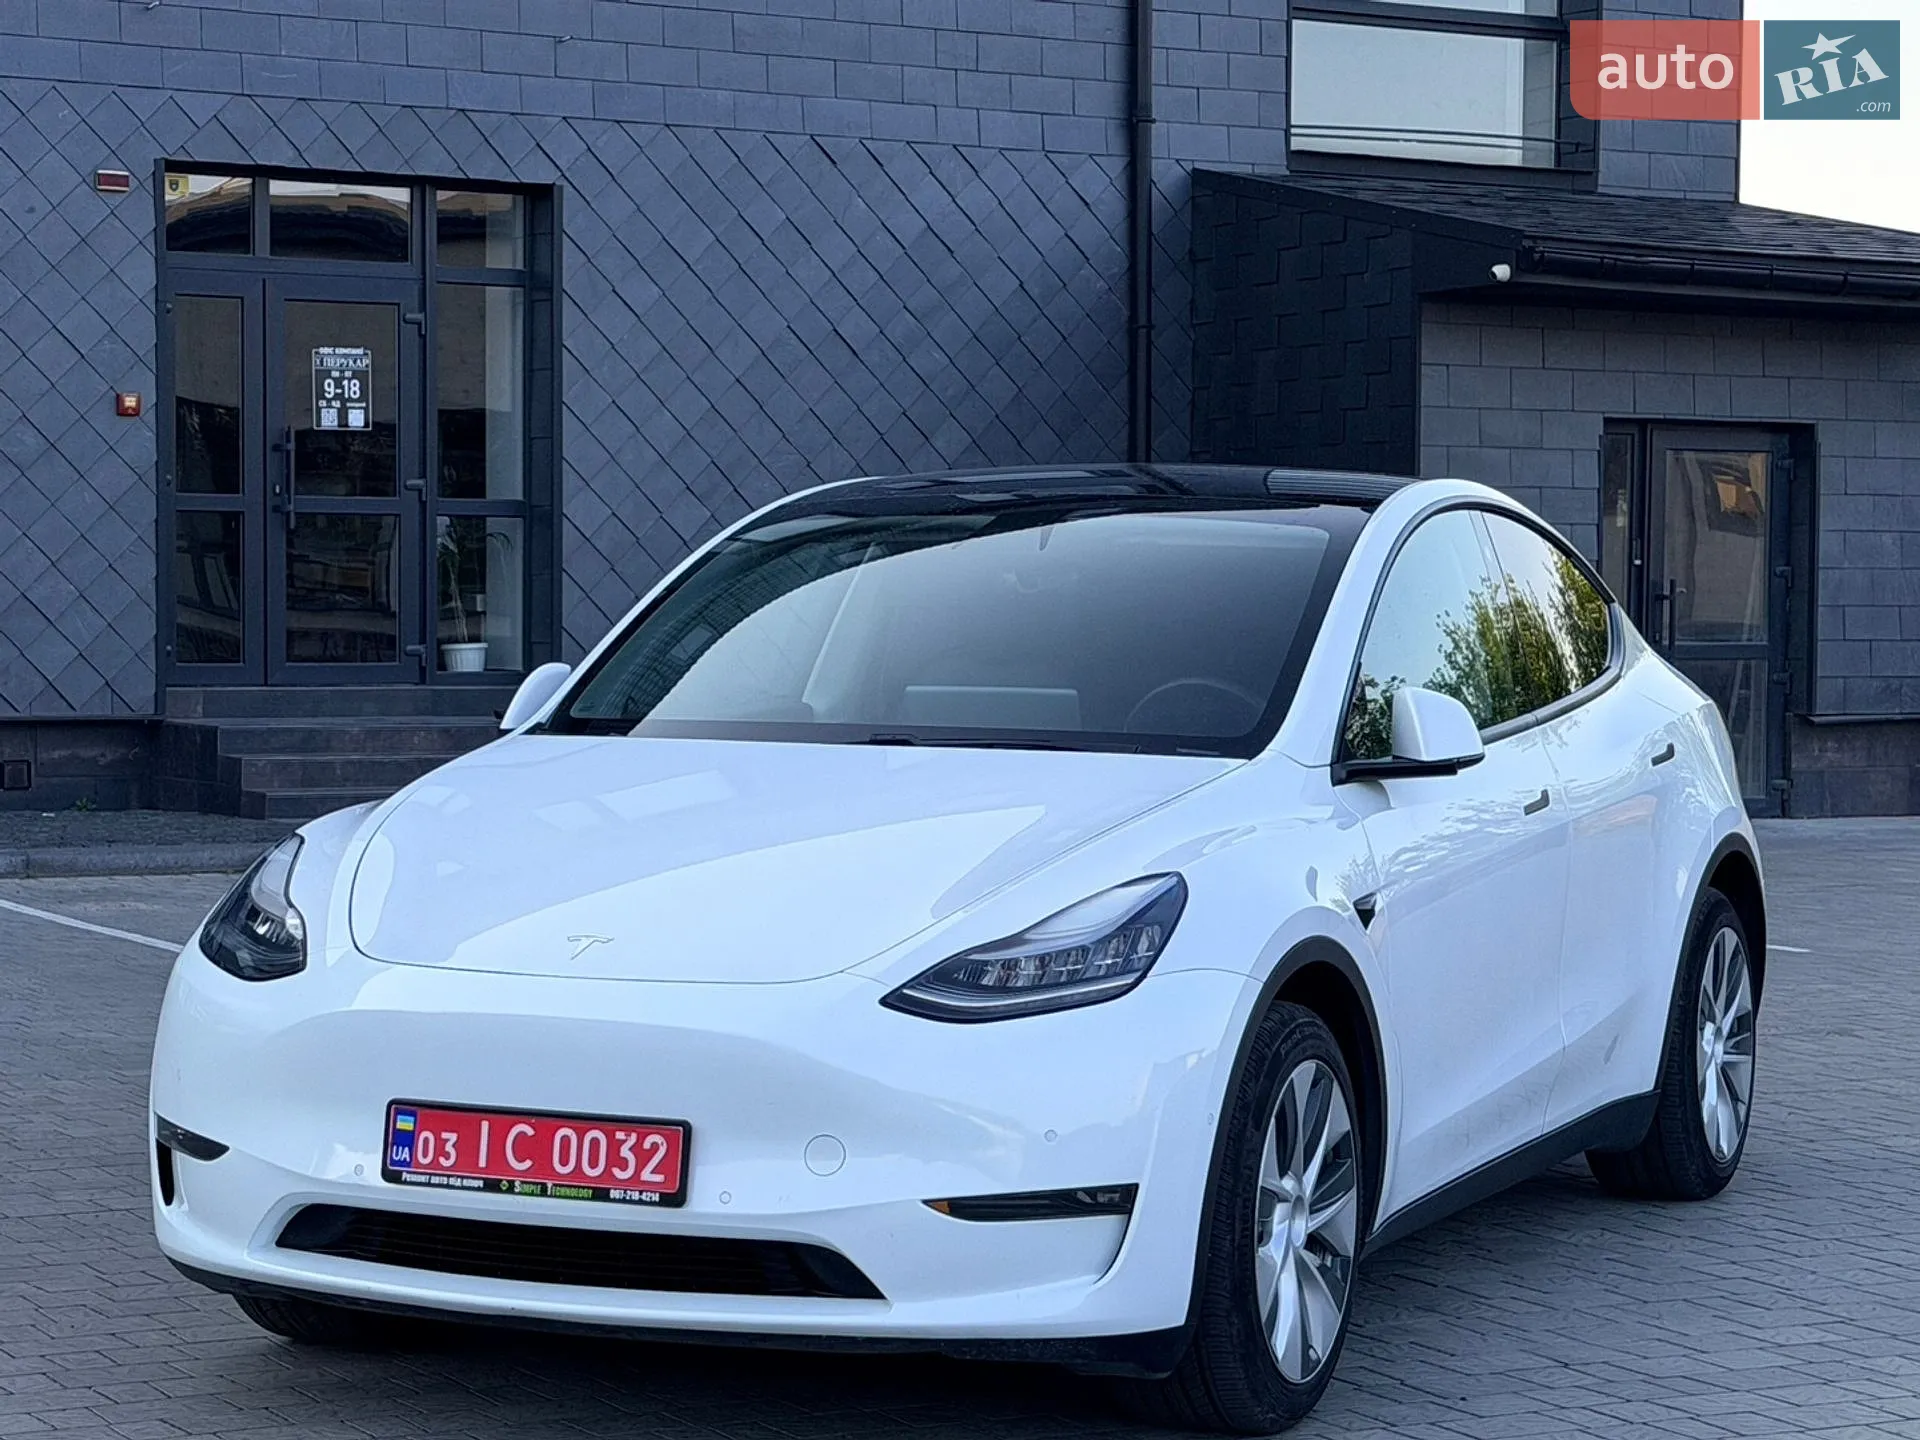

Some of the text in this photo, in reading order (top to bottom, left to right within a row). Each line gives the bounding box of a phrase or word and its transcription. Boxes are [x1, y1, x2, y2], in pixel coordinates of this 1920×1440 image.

[324, 379, 360, 399] 9-18
[392, 1146, 410, 1162] UA
[417, 1130, 458, 1168] 03
[552, 1127, 669, 1183] 0032
